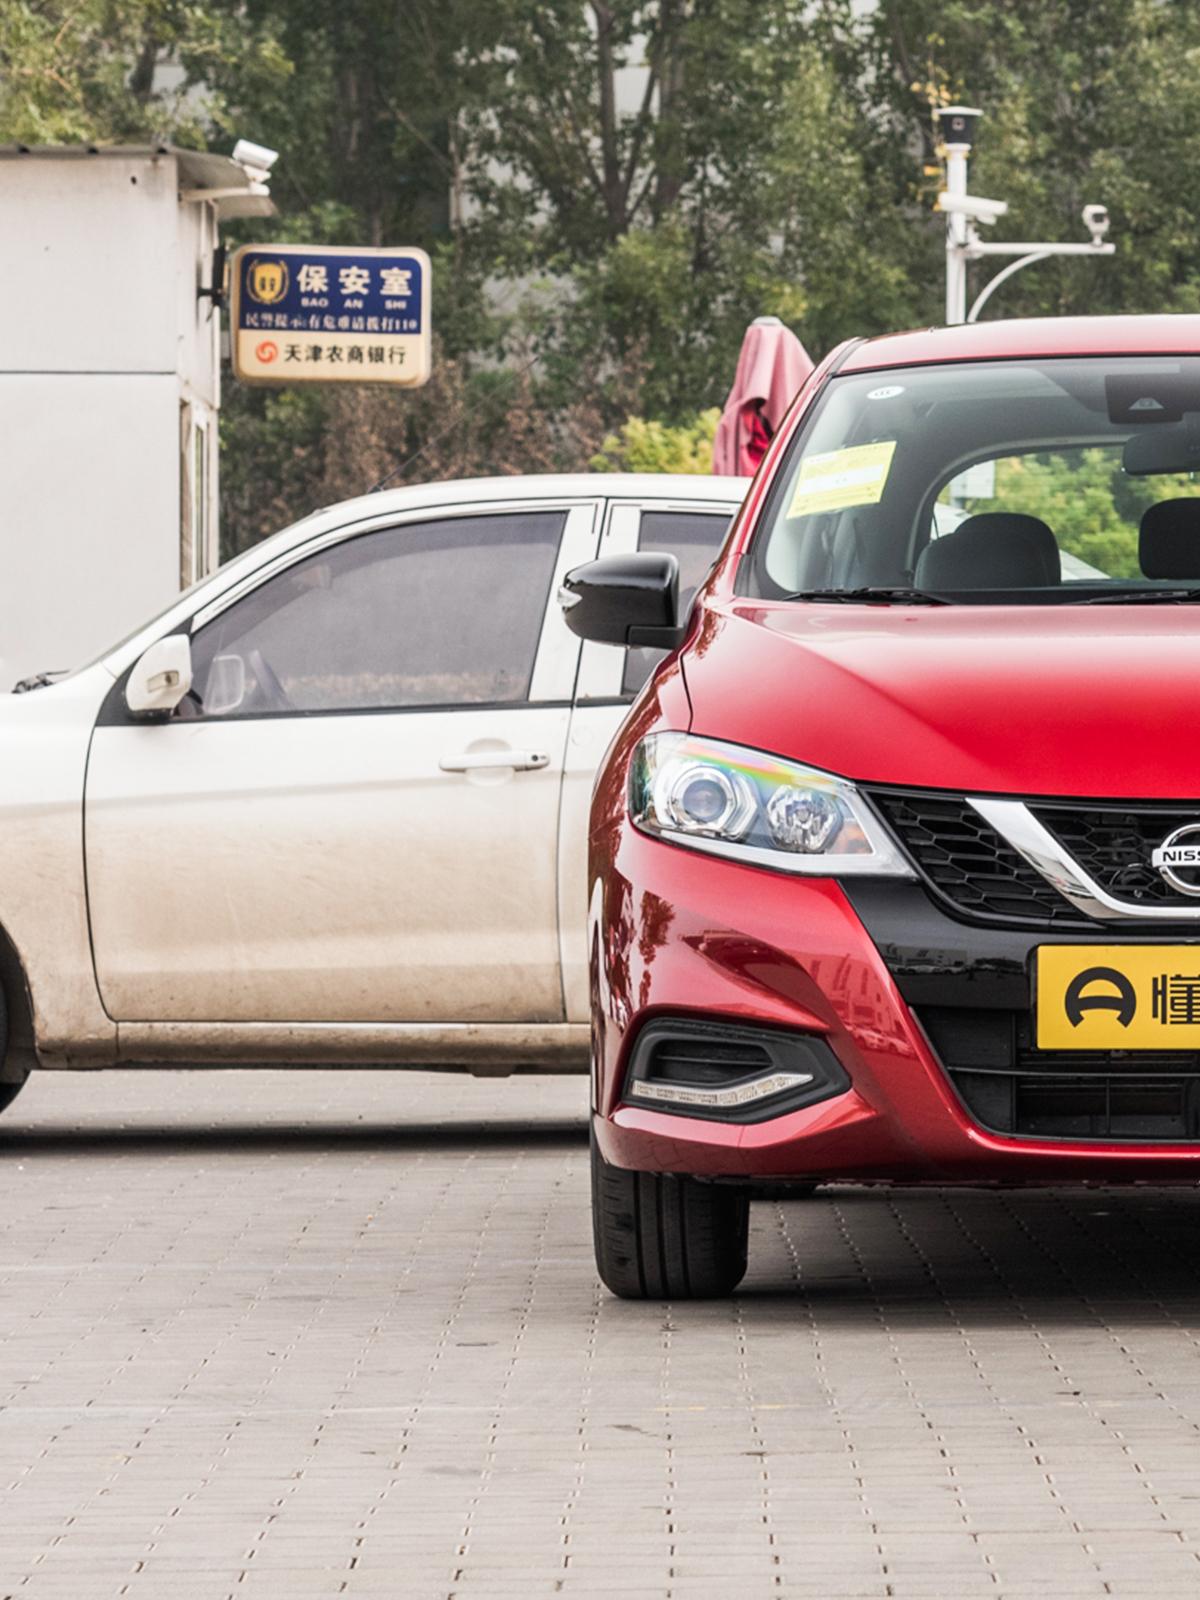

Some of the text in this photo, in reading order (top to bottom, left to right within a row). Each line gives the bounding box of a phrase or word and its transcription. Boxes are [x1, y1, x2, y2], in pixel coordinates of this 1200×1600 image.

[296, 264, 412, 296] 保安室
[301, 298, 407, 310] BAO AN SHI
[284, 344, 406, 364] 天津农商银行
